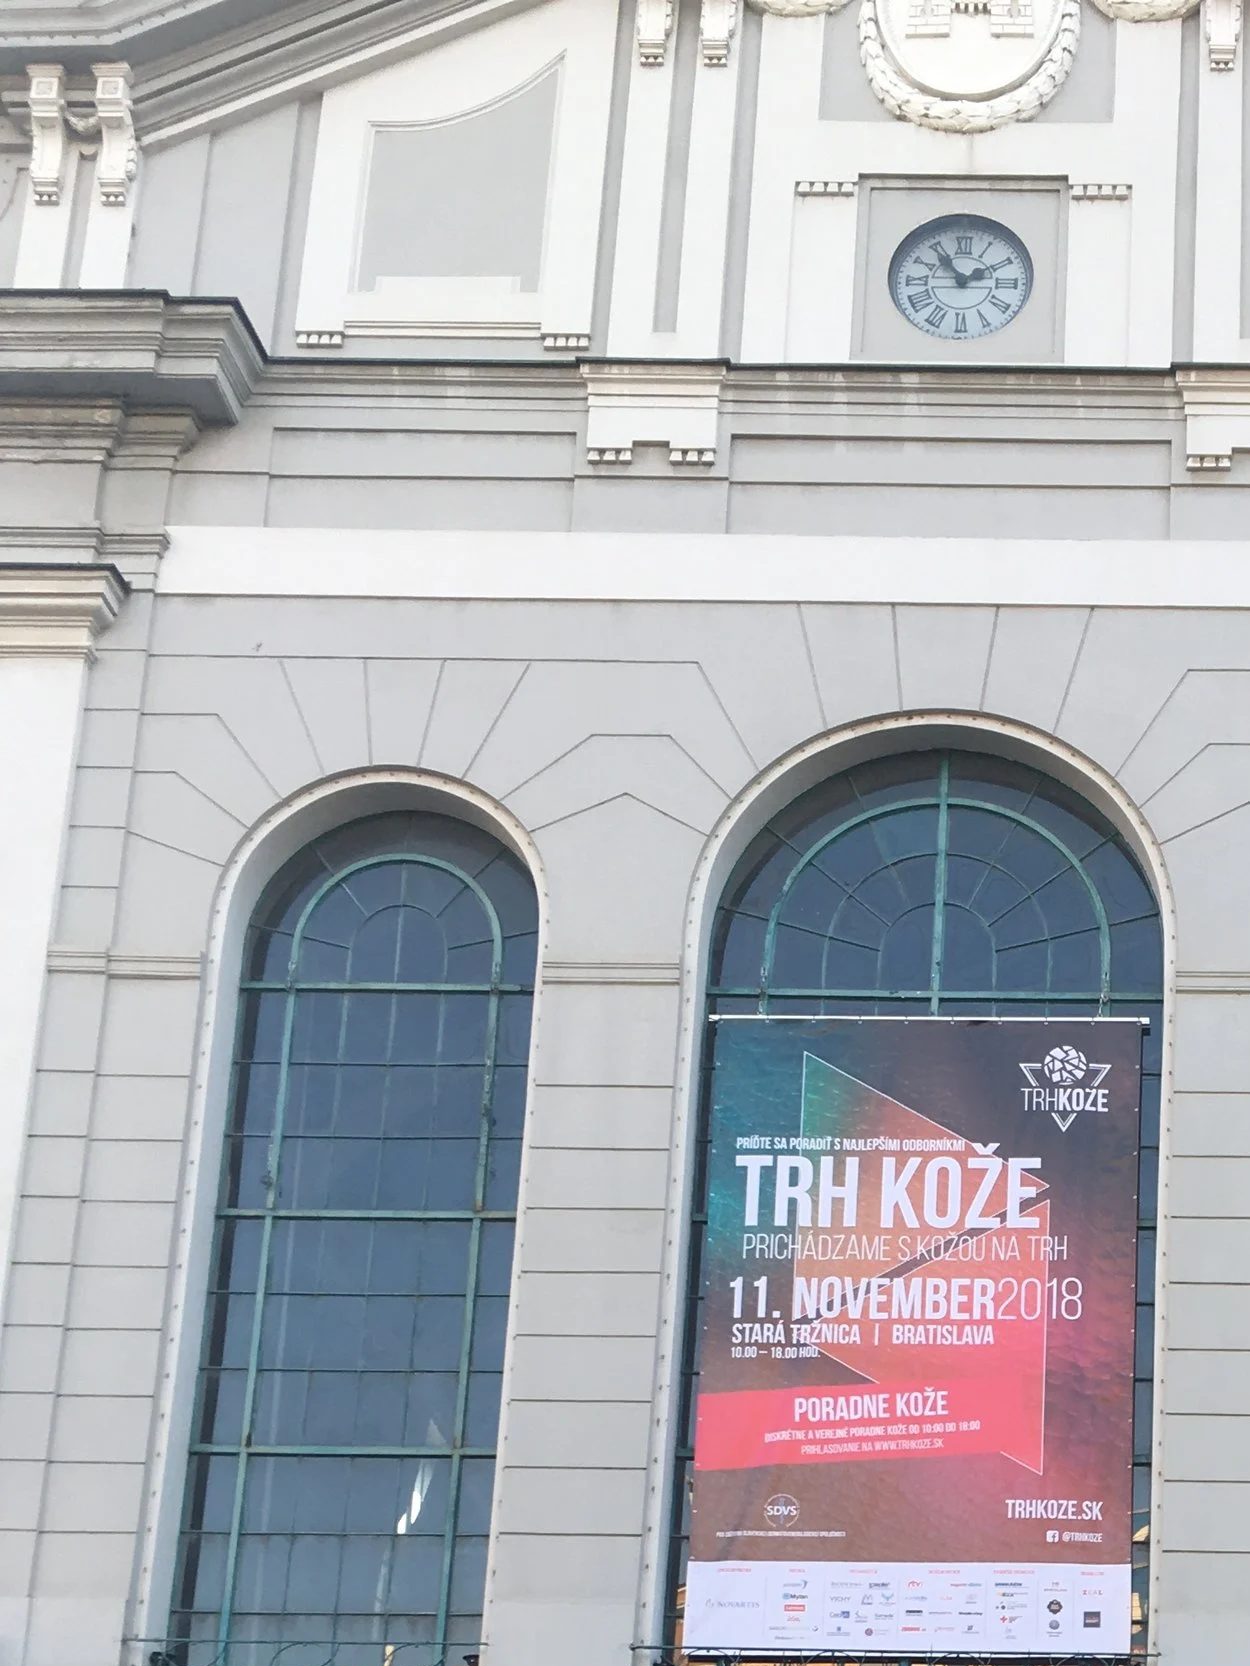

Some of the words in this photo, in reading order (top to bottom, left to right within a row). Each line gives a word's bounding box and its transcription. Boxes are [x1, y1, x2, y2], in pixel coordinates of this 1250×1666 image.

[773, 1137, 788, 1149] SA
[789, 1136, 832, 1150] PORADIŤ
[833, 1137, 841, 1150] S
[843, 1136, 900, 1151] NAJLEPŠÍMI
[902, 1137, 965, 1152] ODBORNÍKMI
[735, 1155, 859, 1228] TRH
[880, 1142, 1042, 1229] KOŽE
[742, 1231, 891, 1261] PRICHÁDZAME
[898, 1235, 911, 1262] S
[916, 1231, 986, 1262] KOŽOU
[991, 1235, 1020, 1261] NA
[1027, 1235, 1068, 1262] TRH
[729, 1276, 781, 1319] 11.
[731, 1320, 786, 1344] STARÁ
[790, 1320, 861, 1345] TRŽNICA
[892, 1324, 995, 1346] BRATISLAVA
[731, 1346, 758, 1359] 10.00
[771, 1347, 797, 1359] 18.00
[799, 1347, 821, 1359] HOD.
[794, 1393, 890, 1423] PORADNE
[896, 1386, 949, 1418] KOŽE
[807, 1430, 814, 1440] A
[850, 1425, 886, 1438] PORADNE
[945, 1421, 956, 1432] DO
[766, 1505, 797, 1516] SDVS
[1005, 1499, 1103, 1520] TRHKOZE.SK
